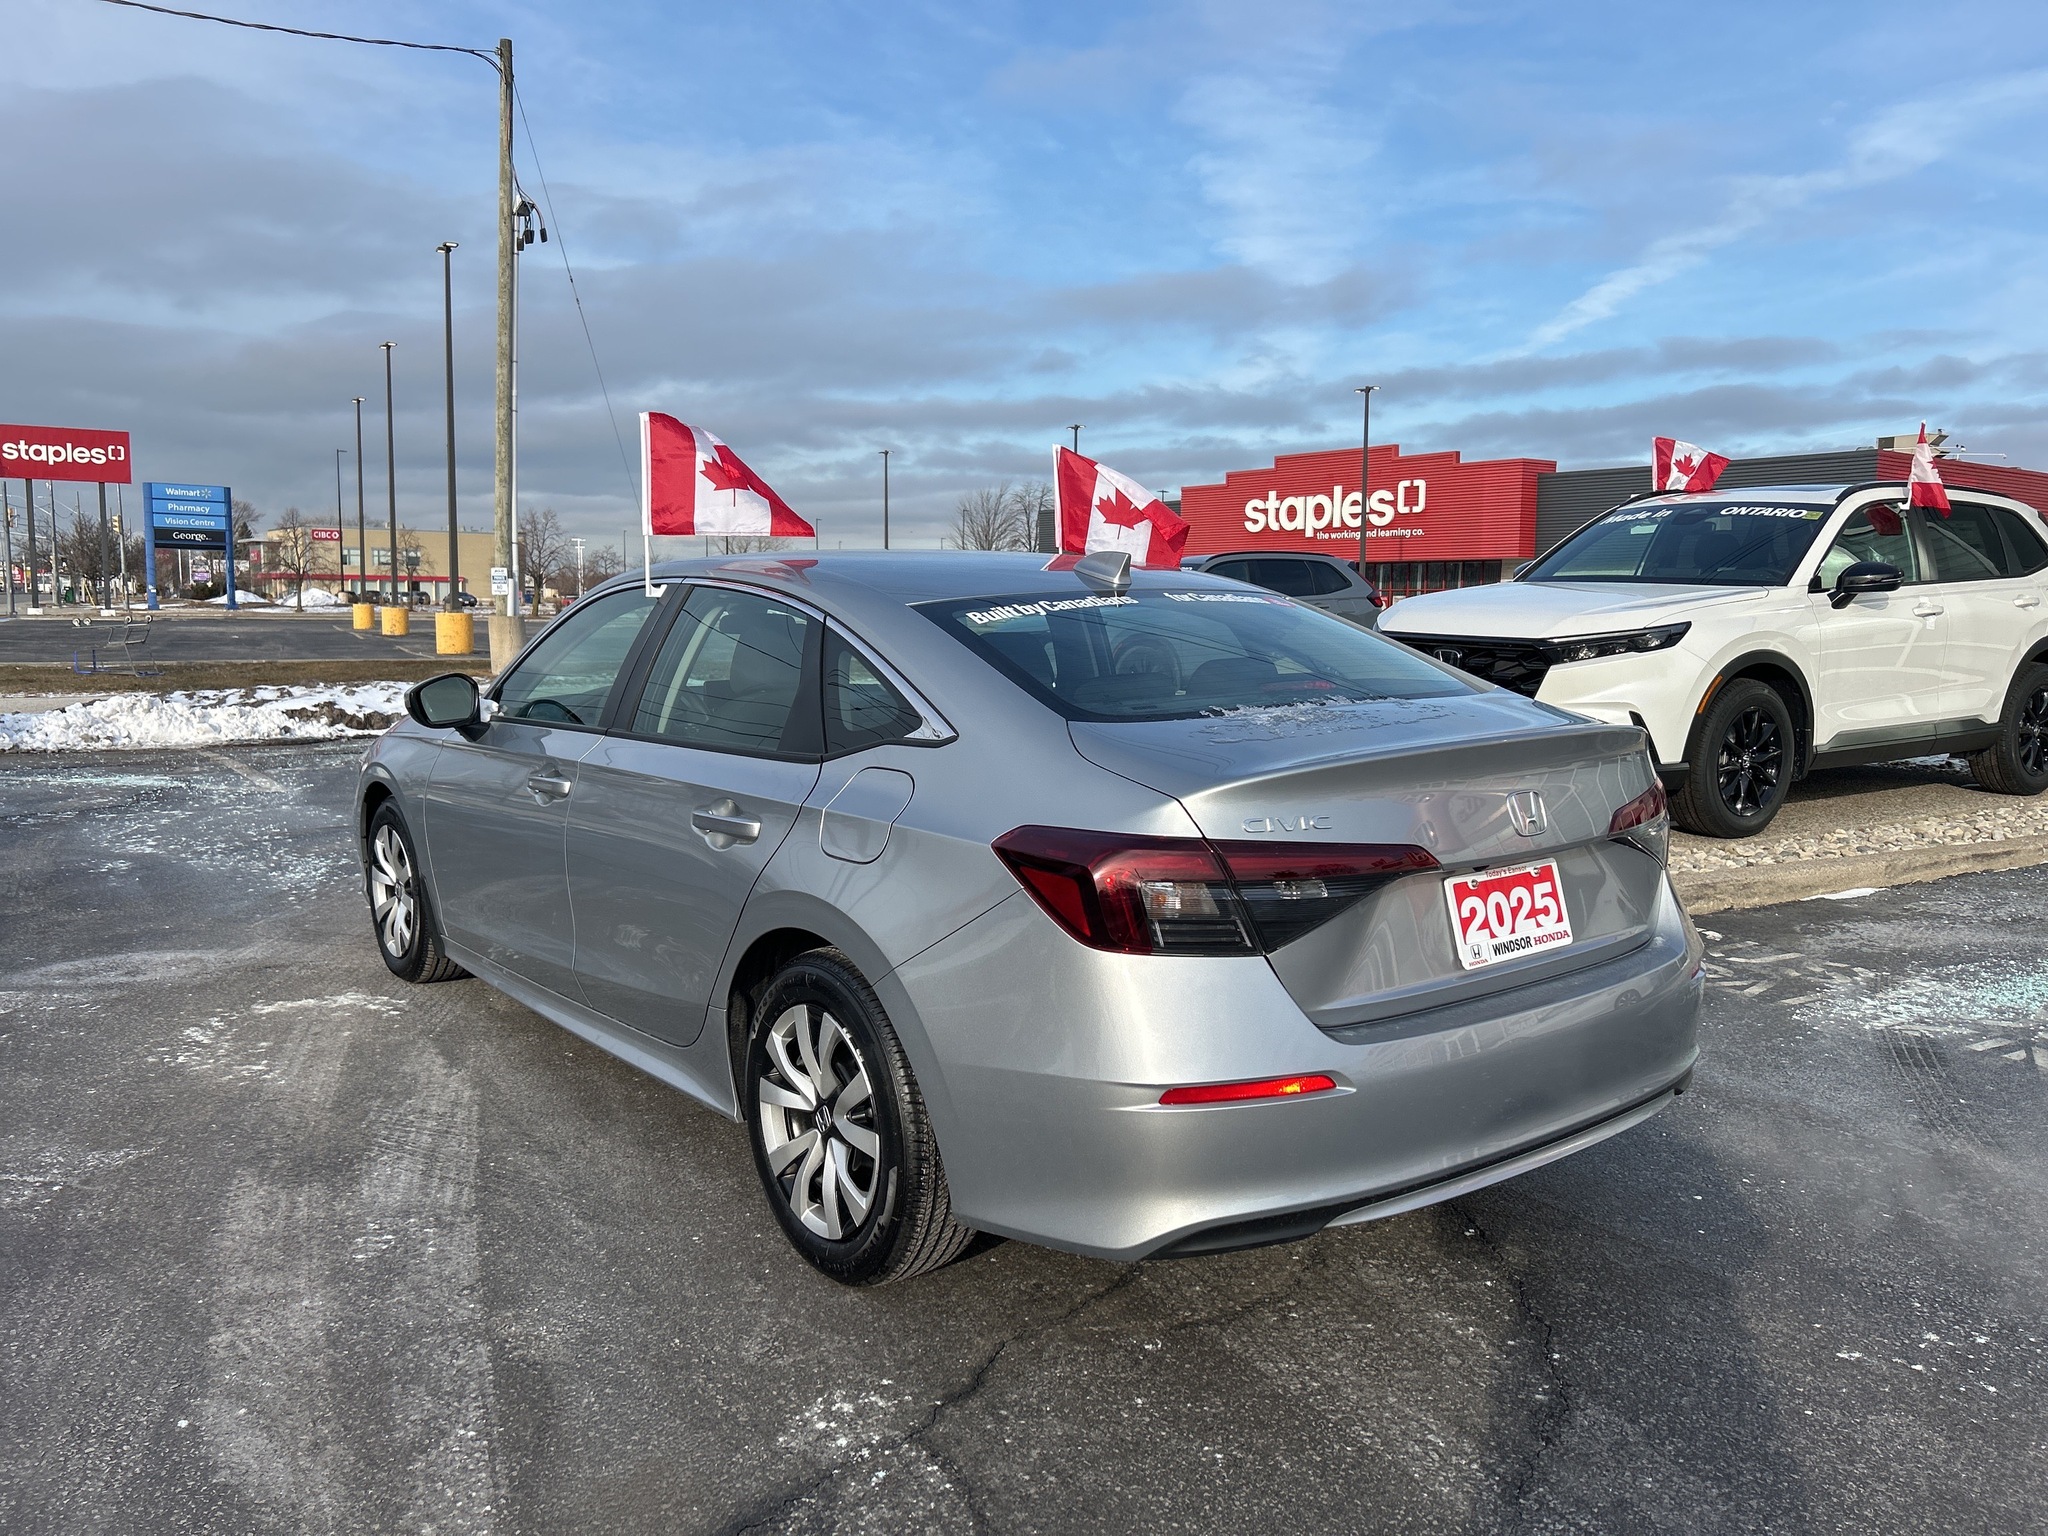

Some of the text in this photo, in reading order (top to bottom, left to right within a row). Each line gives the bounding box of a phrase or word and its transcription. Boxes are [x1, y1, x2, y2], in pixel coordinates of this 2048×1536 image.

[2, 440, 107, 465] staples
[165, 488, 200, 497] Walmart
[167, 503, 210, 514] Pharmacy
[1243, 485, 1395, 537] staples
[1651, 509, 1673, 518] in
[1720, 506, 1808, 518] ONTARIO
[164, 517, 215, 527] Vision Centre
[313, 531, 331, 539] CIBC
[1316, 531, 1329, 540] the
[1330, 529, 1361, 540] working
[1378, 527, 1411, 538] learning
[1412, 528, 1425, 536] co.
[966, 595, 1139, 625] Built by Canadians
[1242, 815, 1333, 834] CIVIC
[1460, 881, 1559, 945] 2025
[1492, 930, 1571, 957] WINDSOR HONDA
[1468, 958, 1489, 968] HONDA
